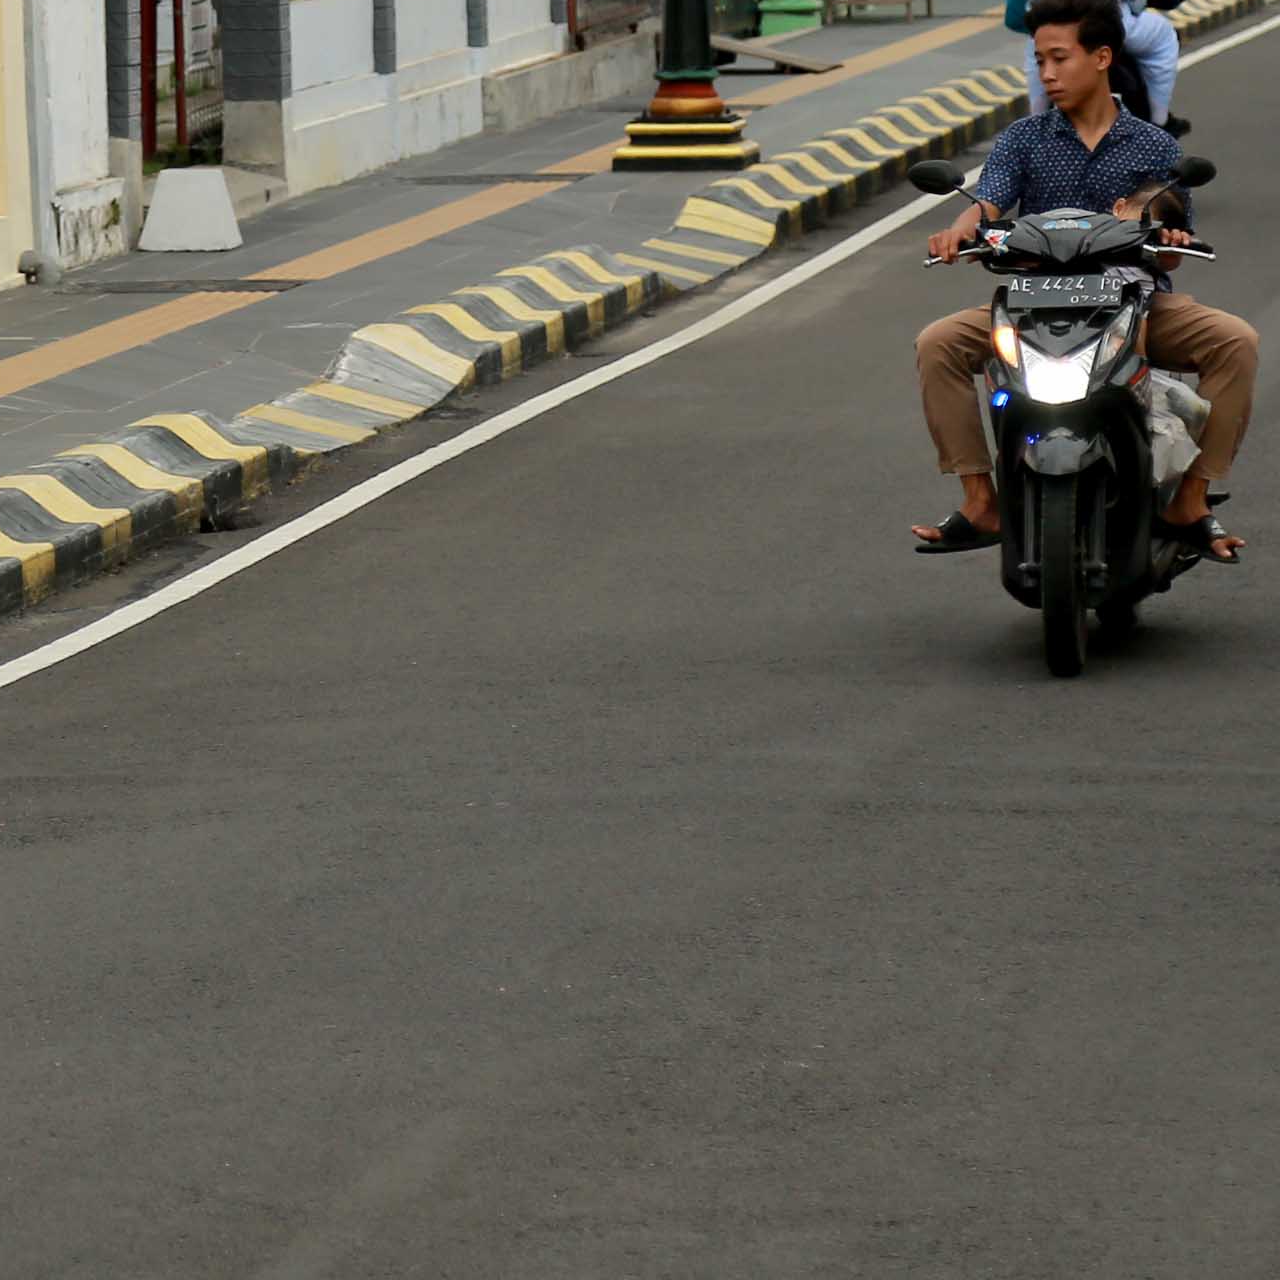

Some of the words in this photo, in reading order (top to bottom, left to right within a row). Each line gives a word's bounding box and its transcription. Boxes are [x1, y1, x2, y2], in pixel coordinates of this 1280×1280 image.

[1010, 278, 1032, 292] AE
[1041, 277, 1085, 291] 4424
[1100, 277, 1120, 291] PC
